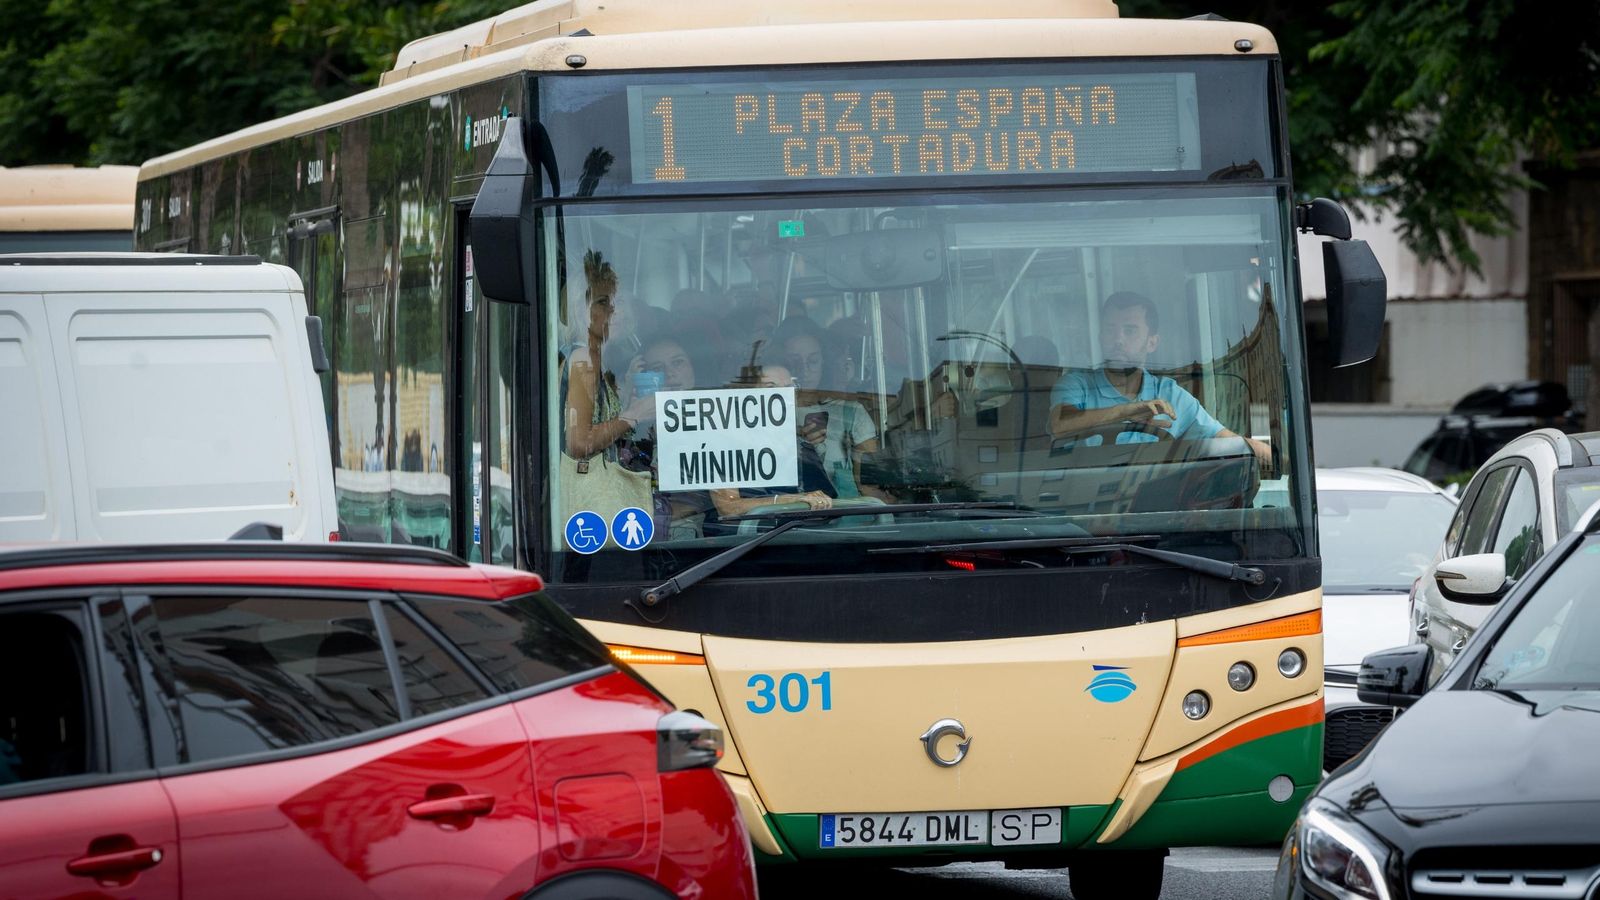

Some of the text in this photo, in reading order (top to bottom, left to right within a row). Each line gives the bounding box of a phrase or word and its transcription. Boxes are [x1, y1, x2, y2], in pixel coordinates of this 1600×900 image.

[735, 86, 1116, 134] PLAZA ESPAÑA
[652, 96, 685, 180] 1
[783, 130, 1075, 176] CORTADURA
[307, 160, 323, 184] SALIDA
[664, 393, 787, 433] SERVICIO
[679, 442, 777, 485] MÍNIMO
[746, 671, 832, 715] 301
[825, 833, 832, 842] E
[840, 815, 979, 843] 5844 DML
